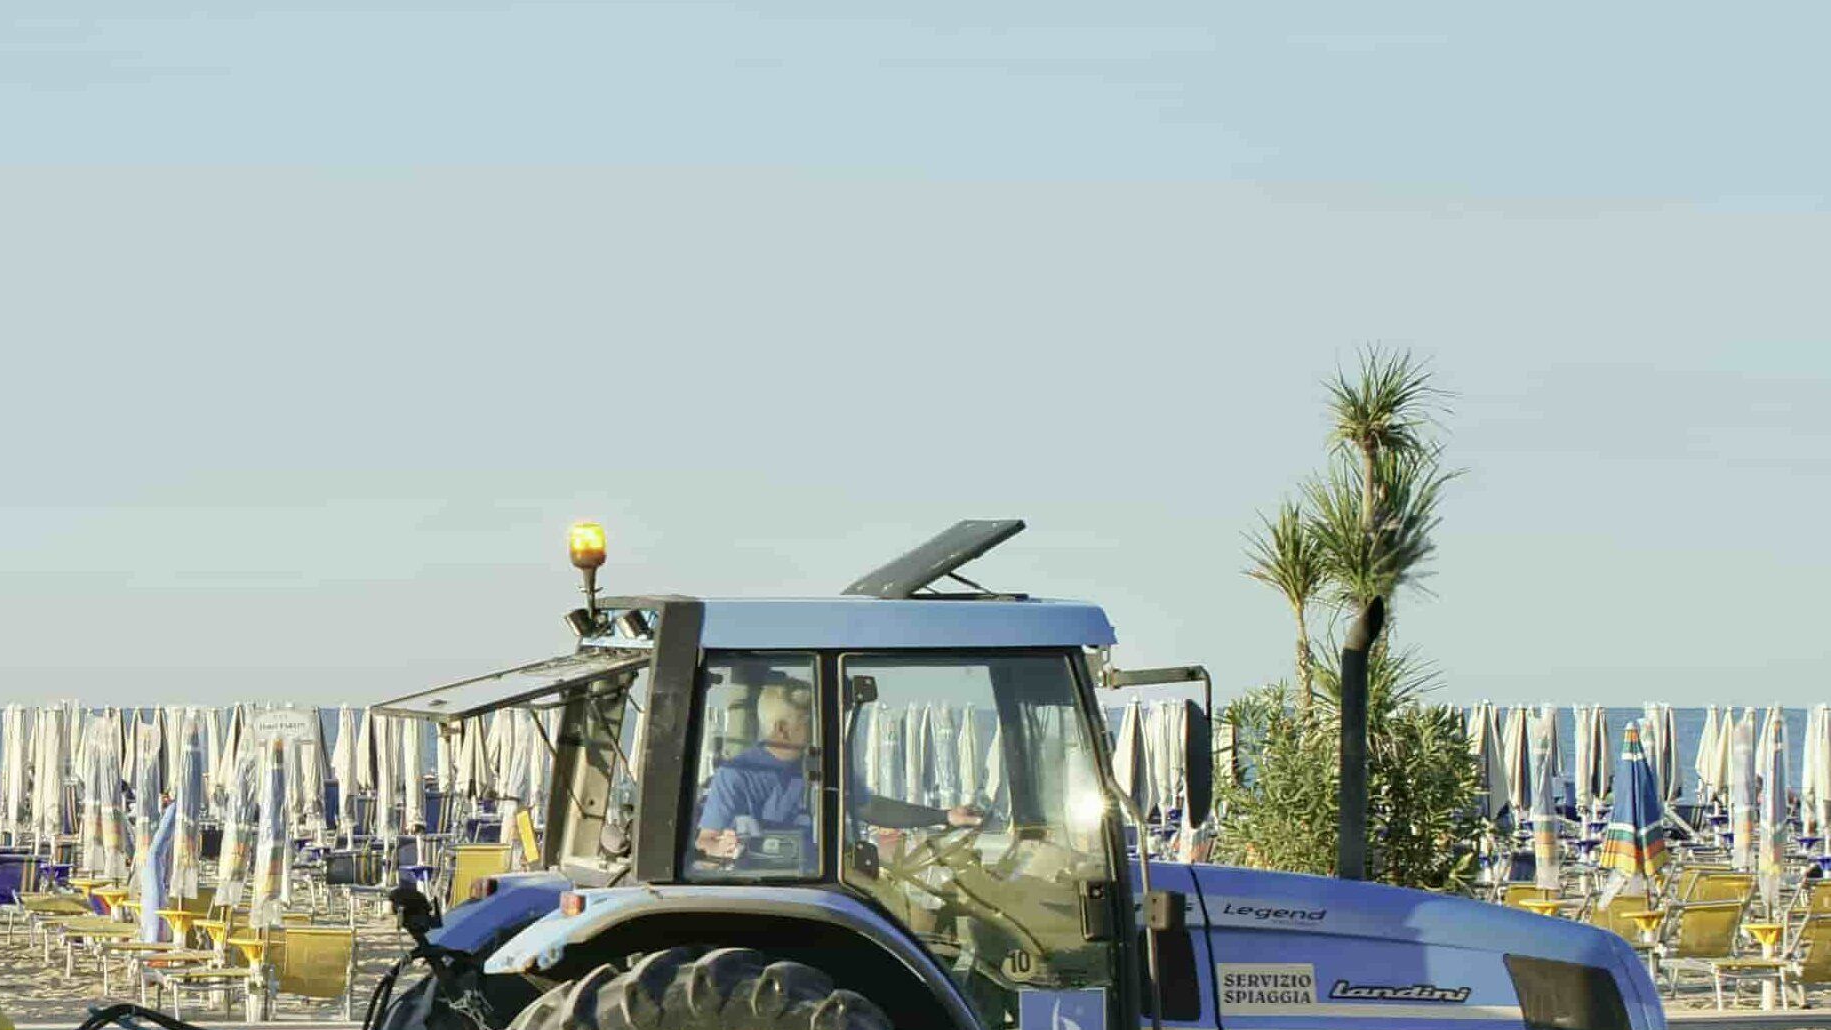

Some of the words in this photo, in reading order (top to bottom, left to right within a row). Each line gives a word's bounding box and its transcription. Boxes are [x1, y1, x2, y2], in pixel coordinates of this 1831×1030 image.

[1223, 903, 1329, 921] Legend
[1007, 949, 1031, 973] 10
[1223, 973, 1312, 988] SERVIZIO
[1223, 989, 1312, 1004] SPIAGGIA
